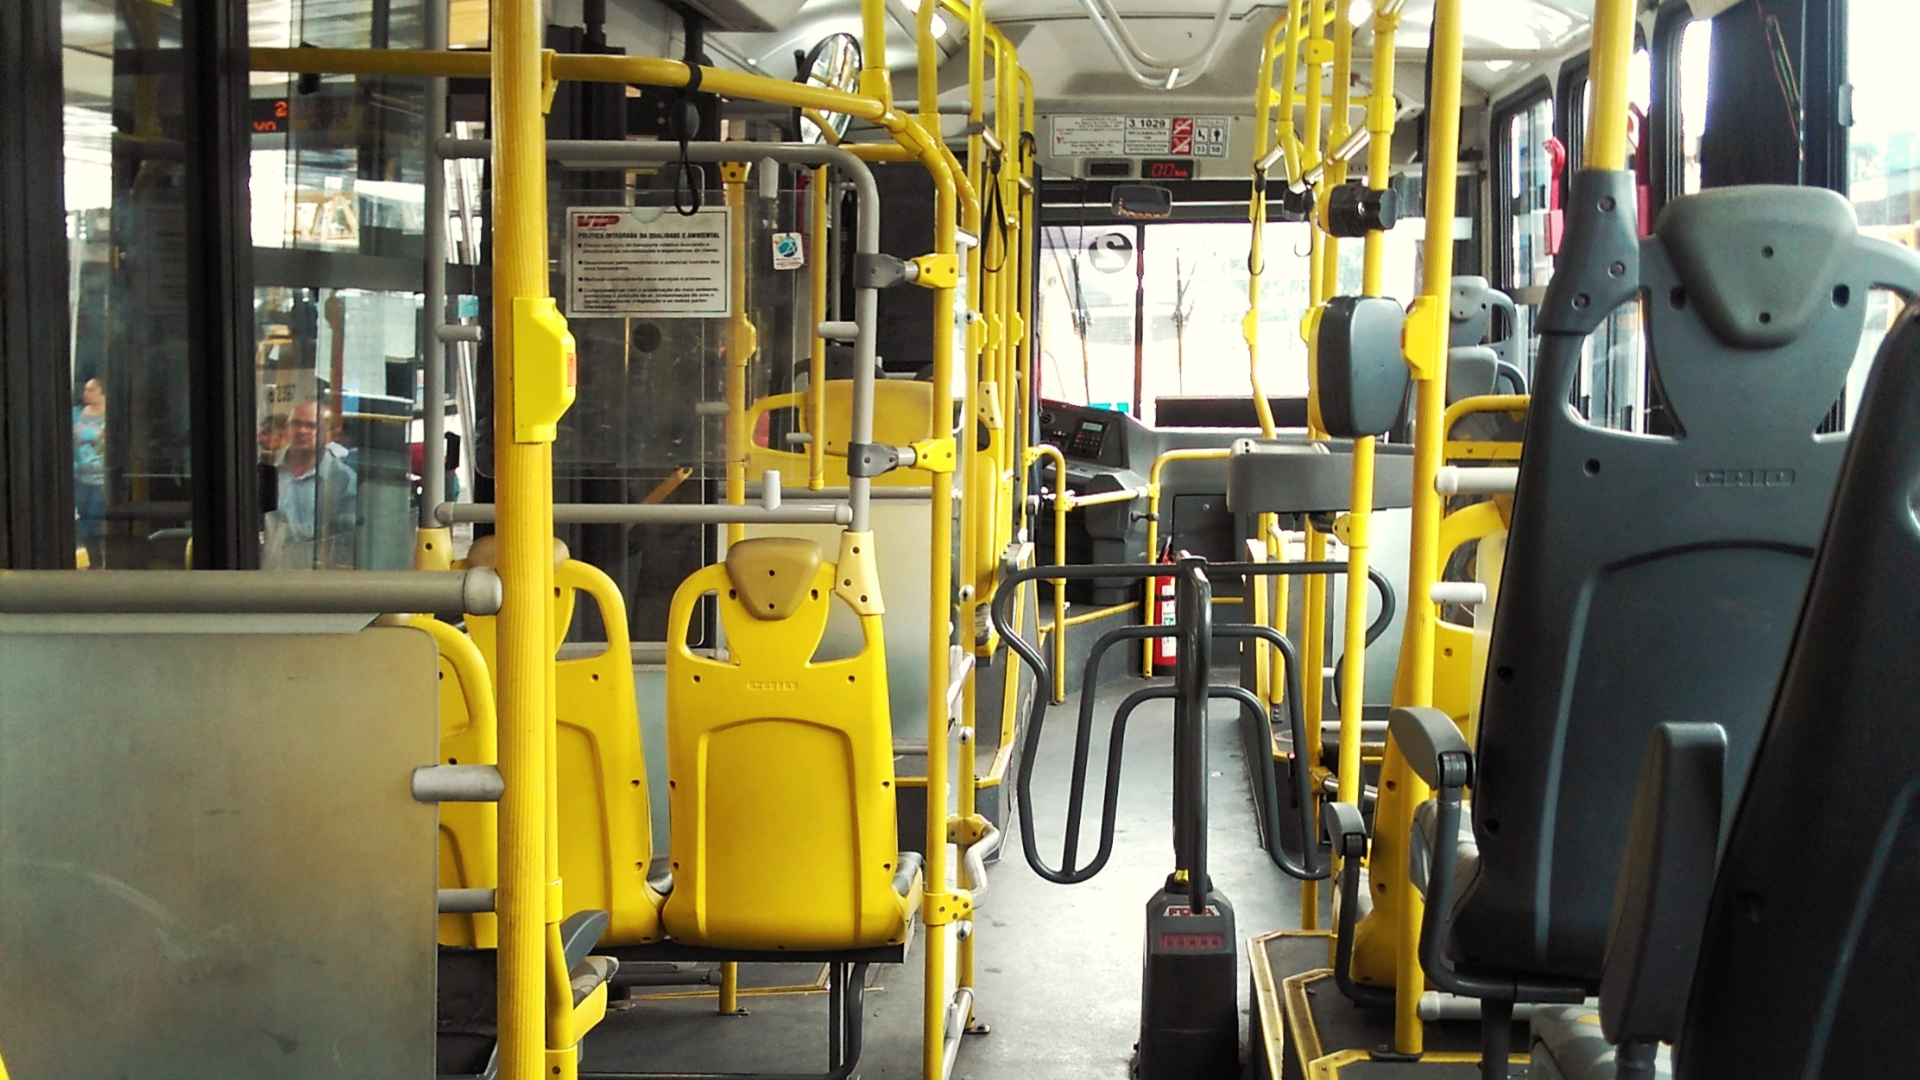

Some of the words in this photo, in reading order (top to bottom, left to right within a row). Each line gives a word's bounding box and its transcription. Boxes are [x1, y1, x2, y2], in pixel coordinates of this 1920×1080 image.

[1128, 118, 1136, 128] 3
[1140, 119, 1166, 128] 1029
[1150, 162, 1175, 177] 00
[577, 215, 620, 227] VIP
